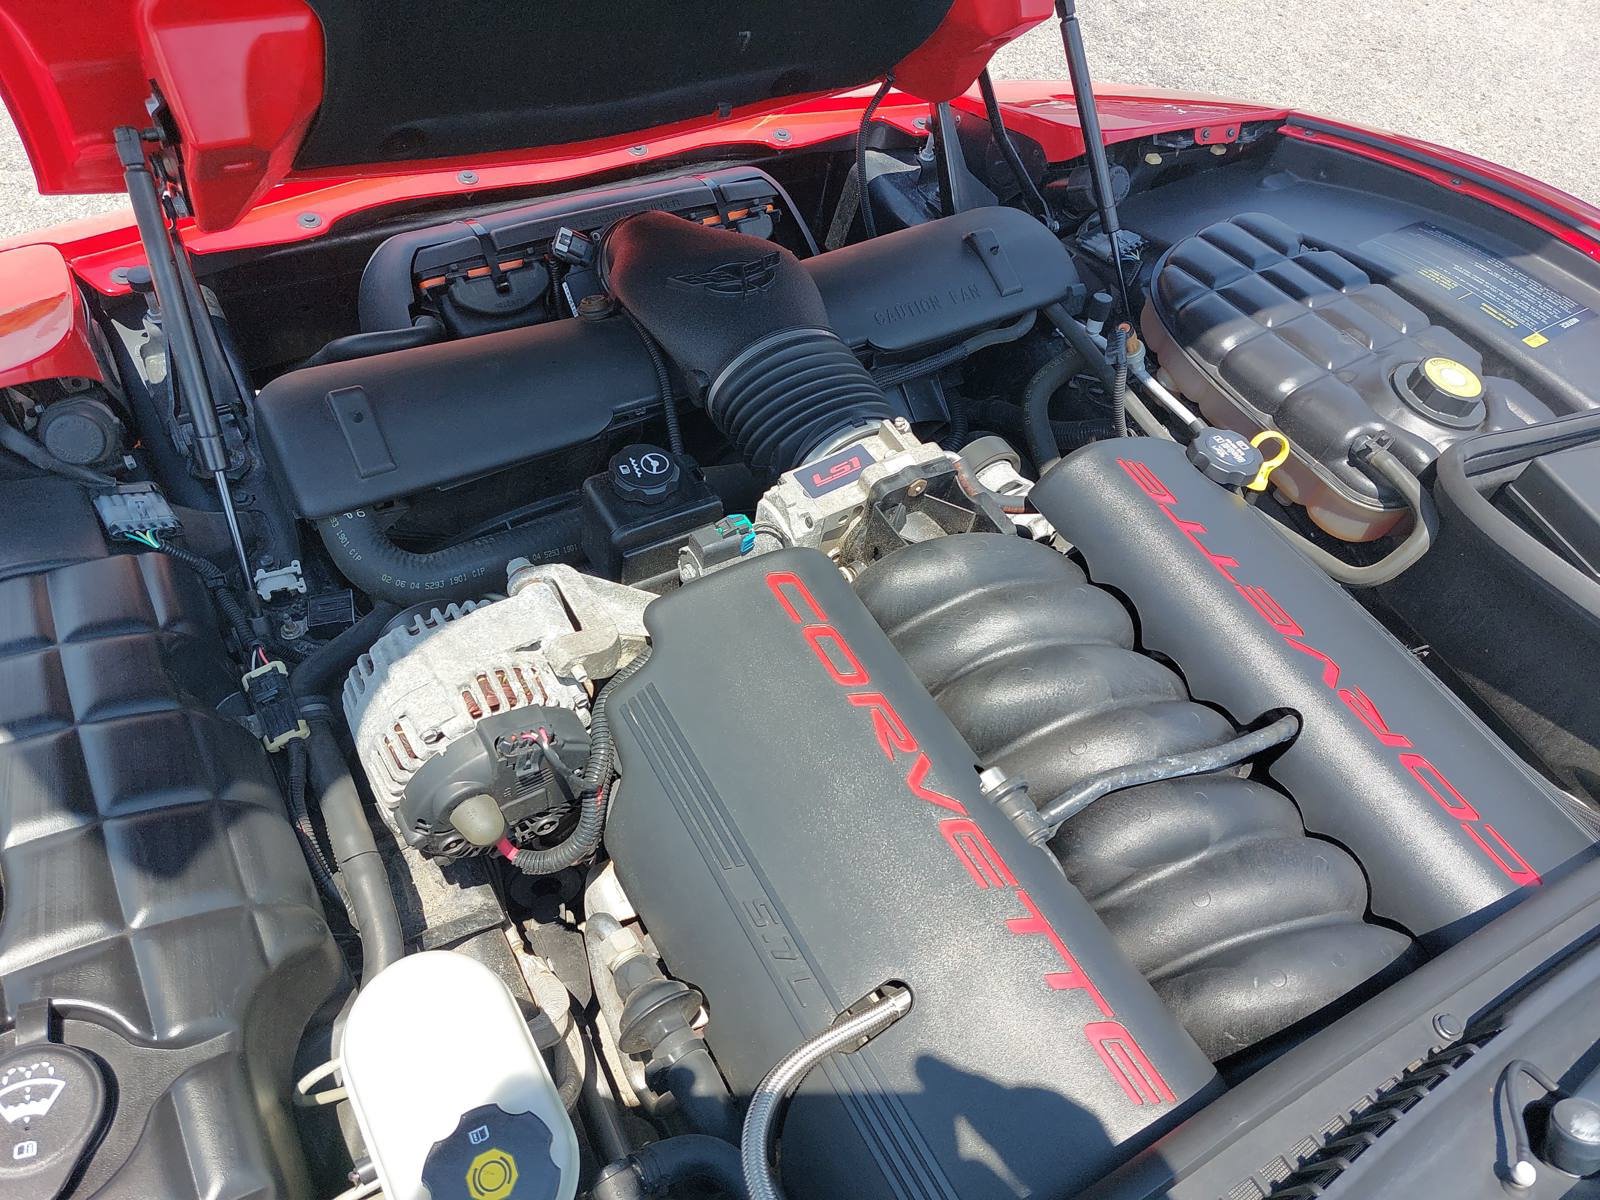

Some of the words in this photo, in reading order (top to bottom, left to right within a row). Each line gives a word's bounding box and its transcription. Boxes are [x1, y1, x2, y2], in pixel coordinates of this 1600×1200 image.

[874, 294, 942, 326] CAUTION
[812, 456, 861, 487] LS1
[1116, 458, 1543, 885] CORVETTE
[765, 571, 1178, 1106] CORVETTE
[741, 897, 812, 1008] 5.7L
